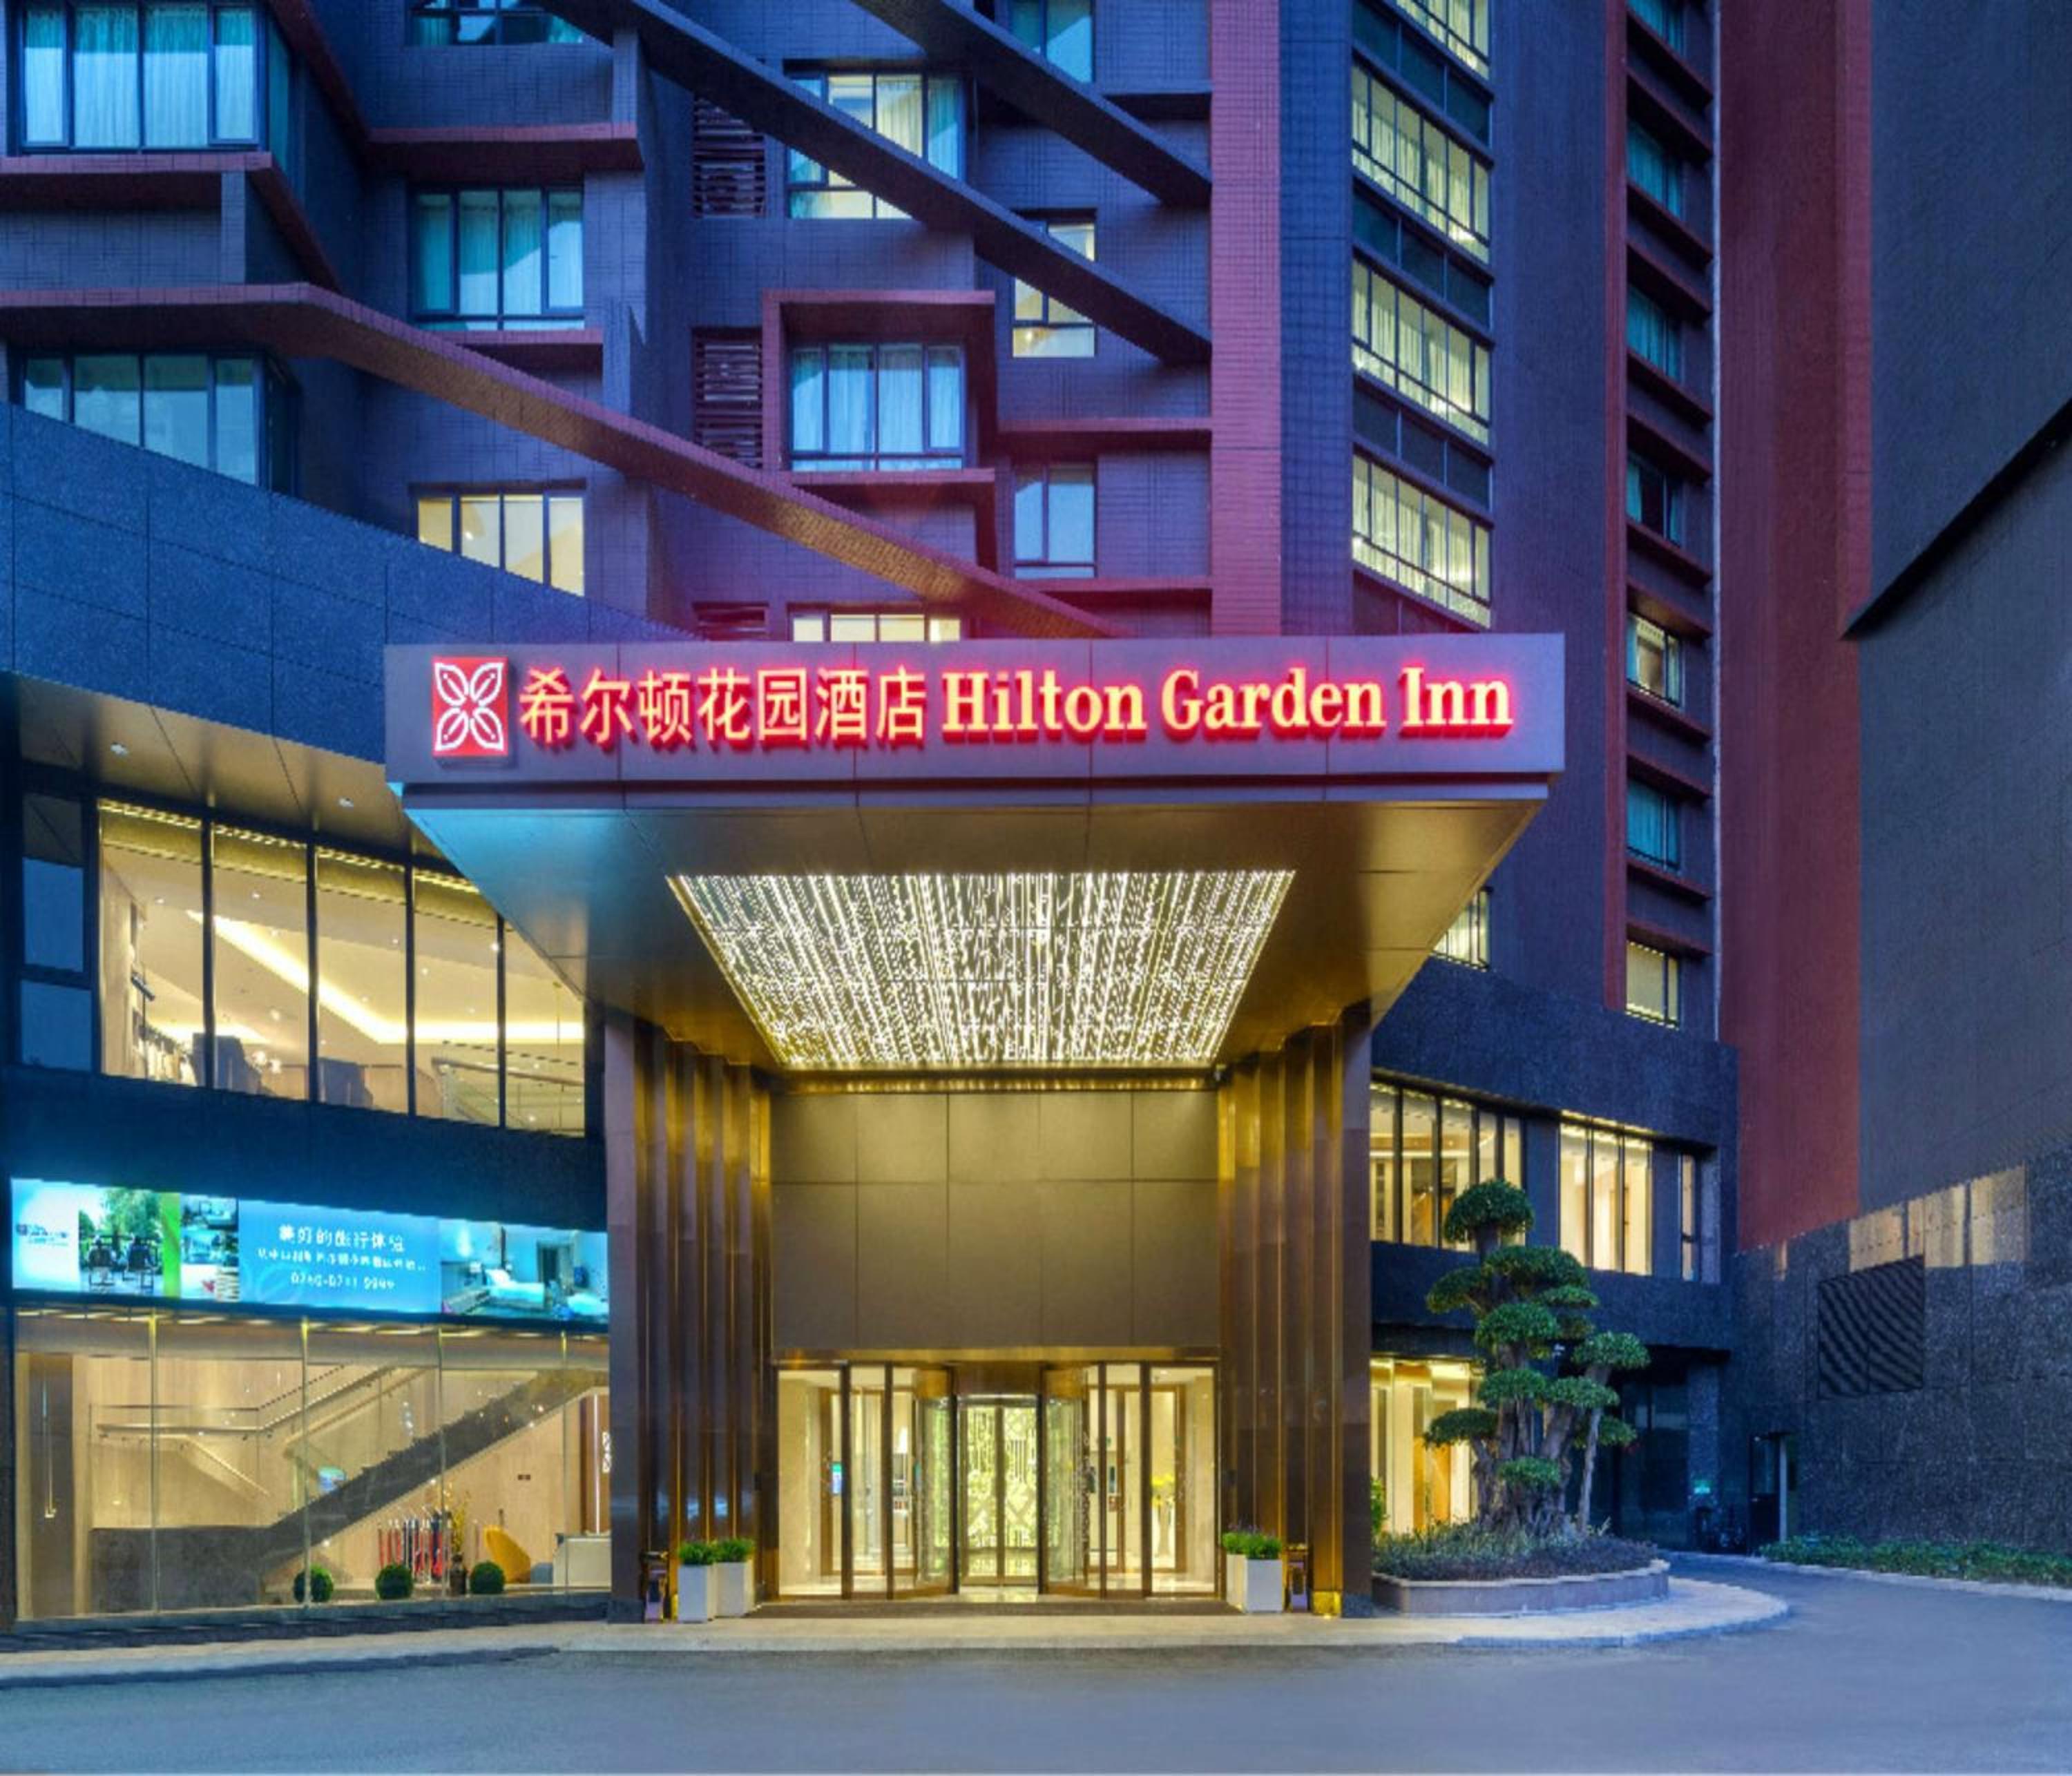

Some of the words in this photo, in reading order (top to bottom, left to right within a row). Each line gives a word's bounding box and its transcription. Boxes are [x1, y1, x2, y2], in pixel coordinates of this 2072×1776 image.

[518, 666, 927, 744] 希尔顿花园酒店
[941, 668, 1147, 735] Hilton
[1160, 666, 1387, 733] Garden
[1399, 665, 1515, 730] Inn
